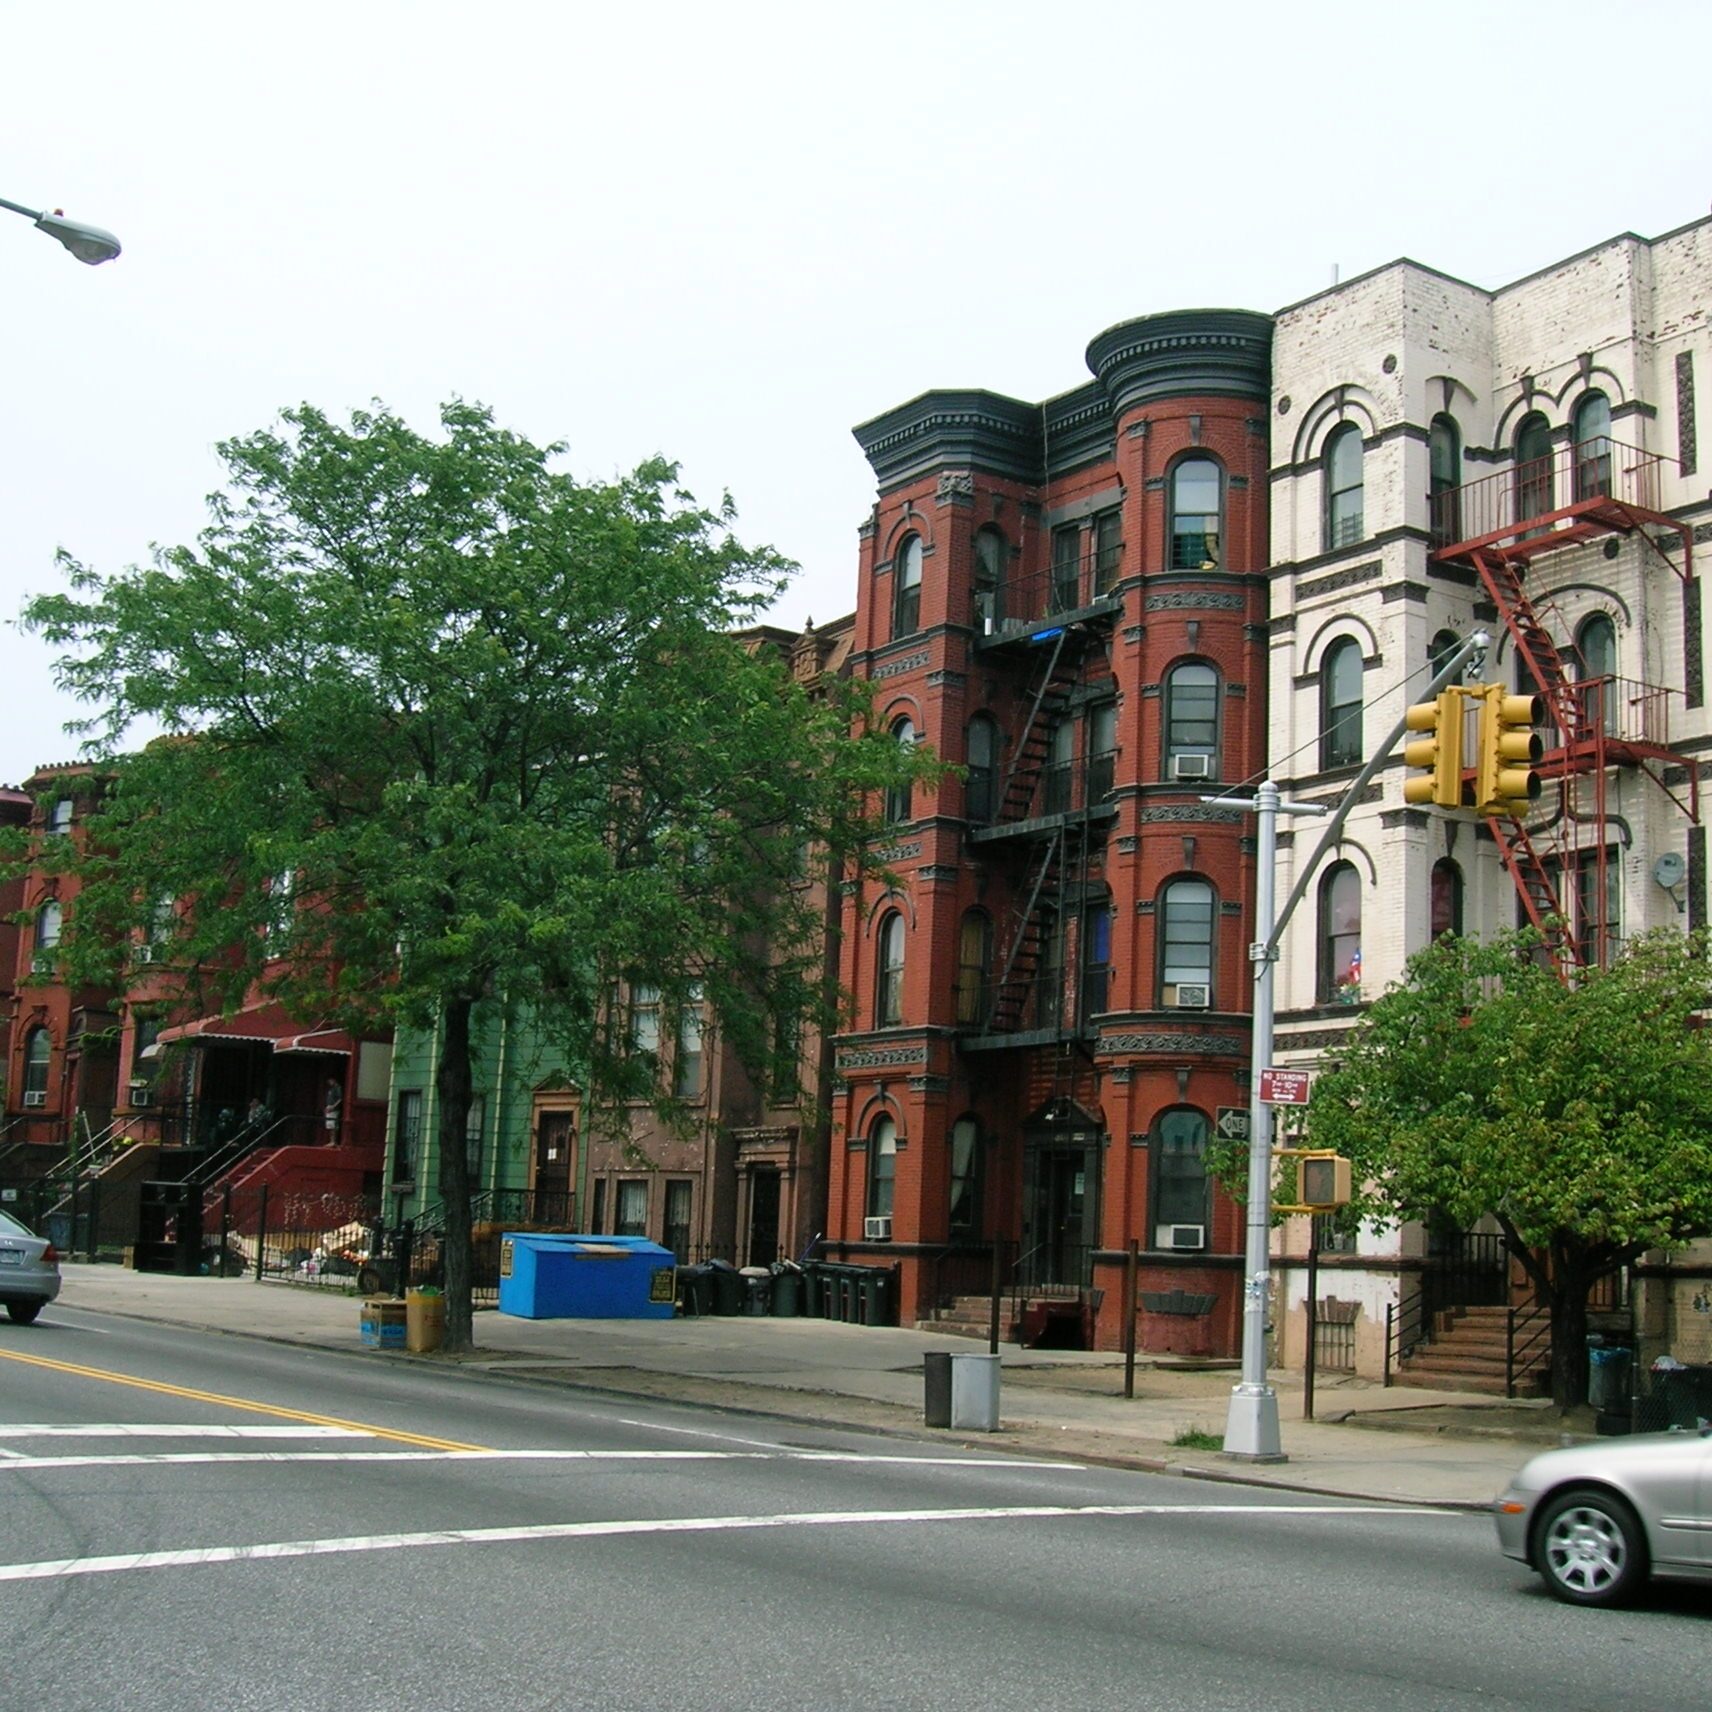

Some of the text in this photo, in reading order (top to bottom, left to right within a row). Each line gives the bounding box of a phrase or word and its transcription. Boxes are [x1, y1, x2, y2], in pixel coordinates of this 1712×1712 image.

[1263, 1072, 1307, 1082] NO STANDING
[1226, 1117, 1243, 1131] ONE
